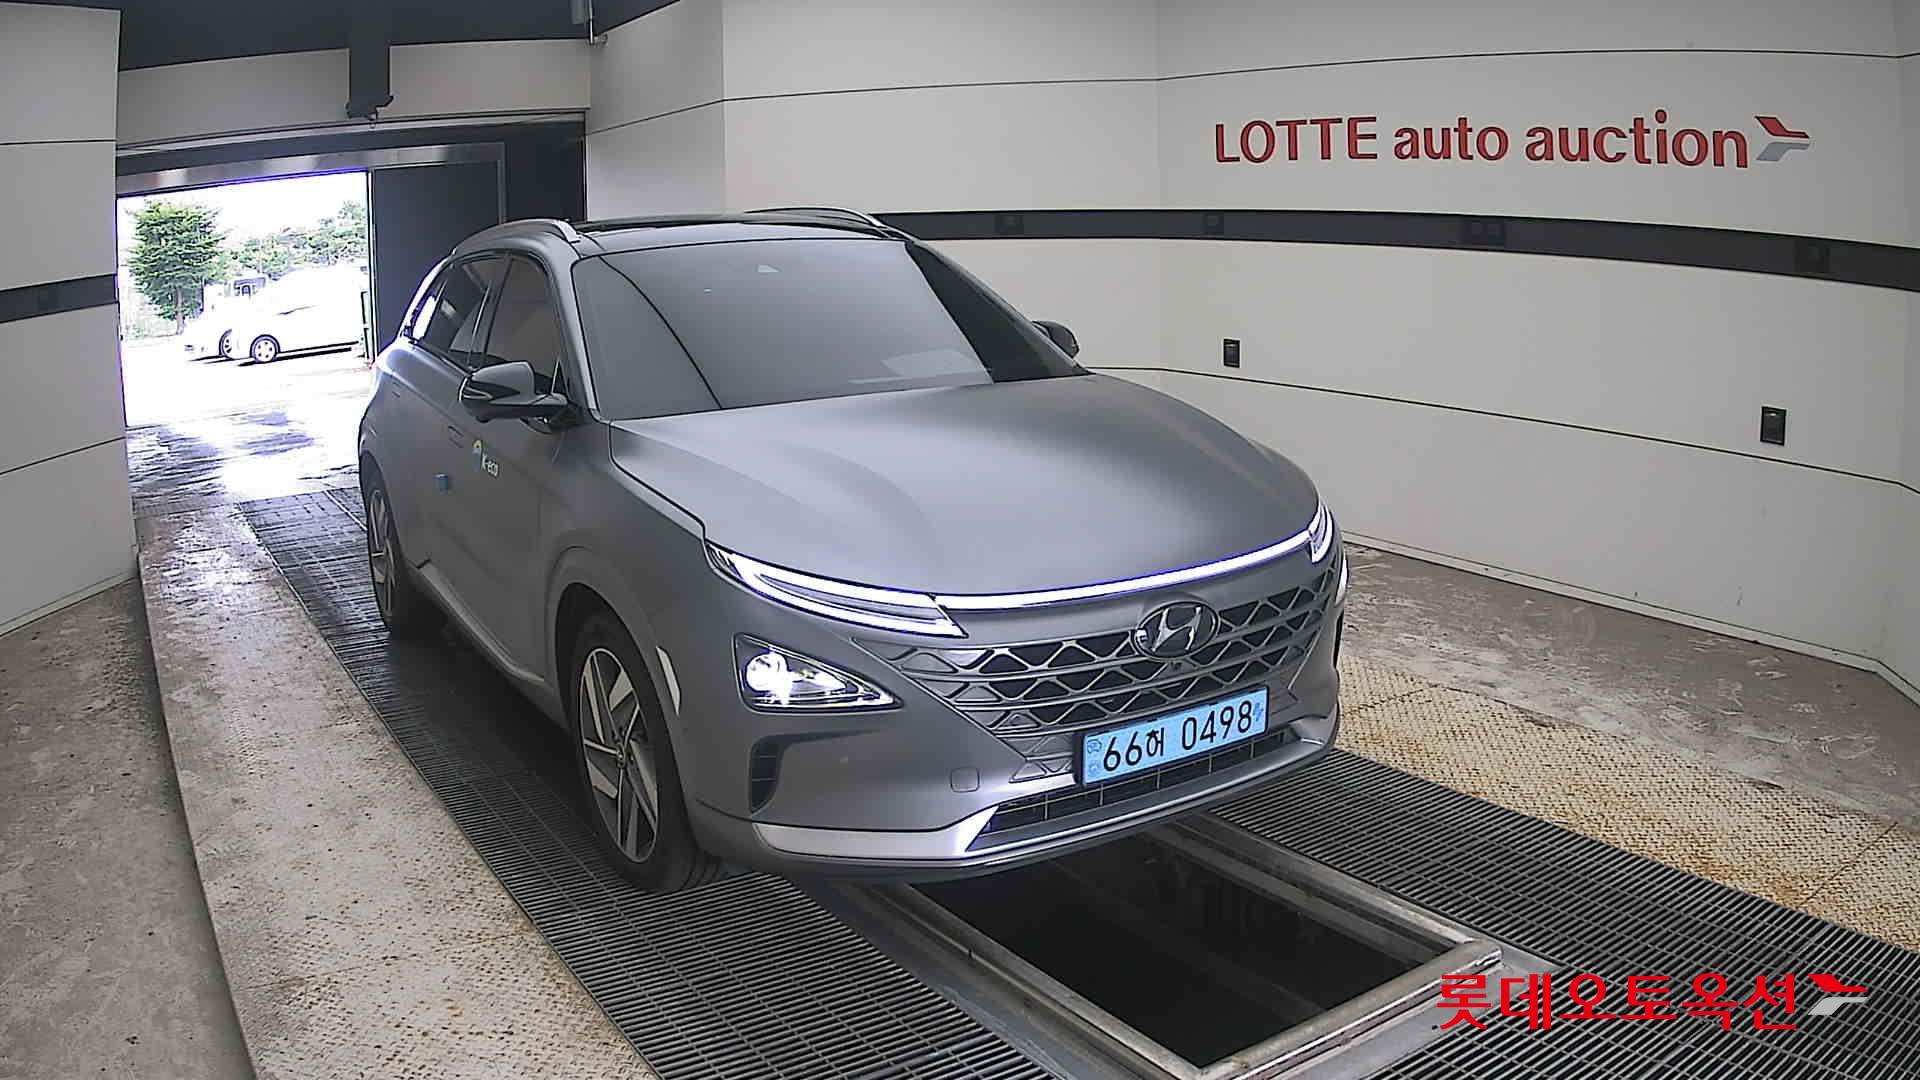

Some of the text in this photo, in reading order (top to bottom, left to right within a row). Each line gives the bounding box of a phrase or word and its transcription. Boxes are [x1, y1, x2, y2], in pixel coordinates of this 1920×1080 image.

[1215, 109, 1749, 169] LOTTE auto auction
[1103, 700, 1252, 772] 66허 0498
